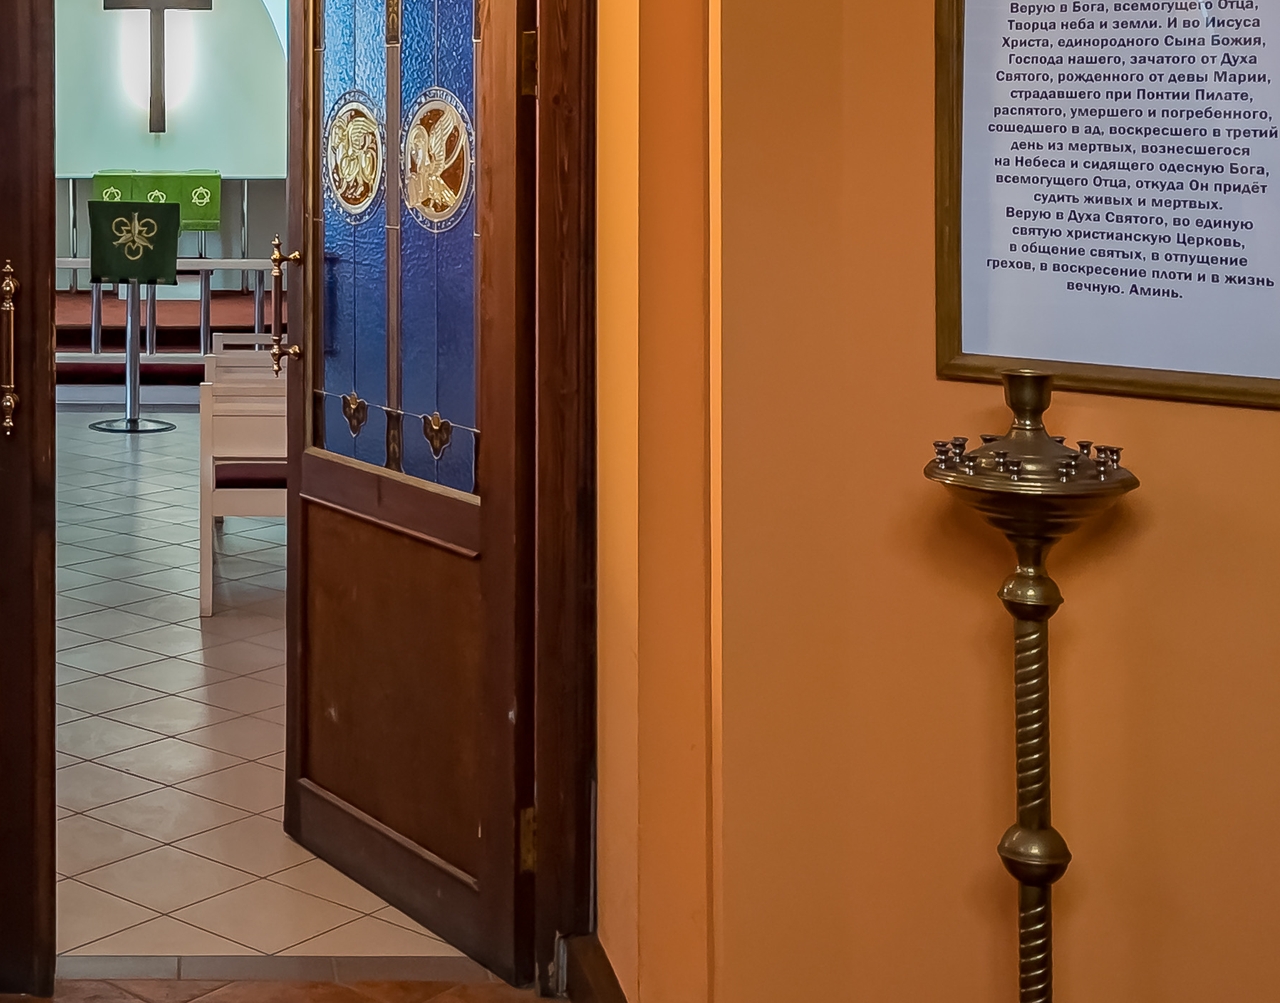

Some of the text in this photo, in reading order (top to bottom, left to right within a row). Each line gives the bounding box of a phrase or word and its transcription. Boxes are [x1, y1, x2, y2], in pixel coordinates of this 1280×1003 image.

[1010, 2, 1056, 16] Верую
[1059, 3, 1068, 13] в
[1072, 0, 1109, 14] Бога,
[1007, 16, 1261, 33] Творца неба и земли. И во Иисуса
[1001, 34, 1266, 50] Христа, единородного Сына Божия,
[1008, 52, 1257, 67] Господа нашего, зачатого от Духа
[995, 70, 1271, 86] Святого, рожденного от девы Марии,
[1010, 88, 1254, 104] страдавшего при Понтии Пилате,
[993, 106, 1273, 122] распятого, умершего и погребенного,
[988, 123, 1279, 141] сошедшего в ад, воскресшего в третий
[1010, 141, 1250, 157] день из мертвых, вознесшегося
[994, 155, 1270, 178] на Небеса и сидящего одесную Бога,
[995, 174, 1268, 195] всемогущего Отца, откуда Он придёт
[1033, 193, 1223, 211] судить живых и мертвых.
[1005, 206, 1254, 232] Верую в Духа Святого, во единую
[1012, 226, 1245, 250] святую христианскую Церковь,
[1009, 241, 1248, 267] в общение святых, в отпущение
[986, 258, 1275, 287] грехов, в воскресение плоти и в жизнь
[1066, 281, 1183, 299] вечную. Аминь.
